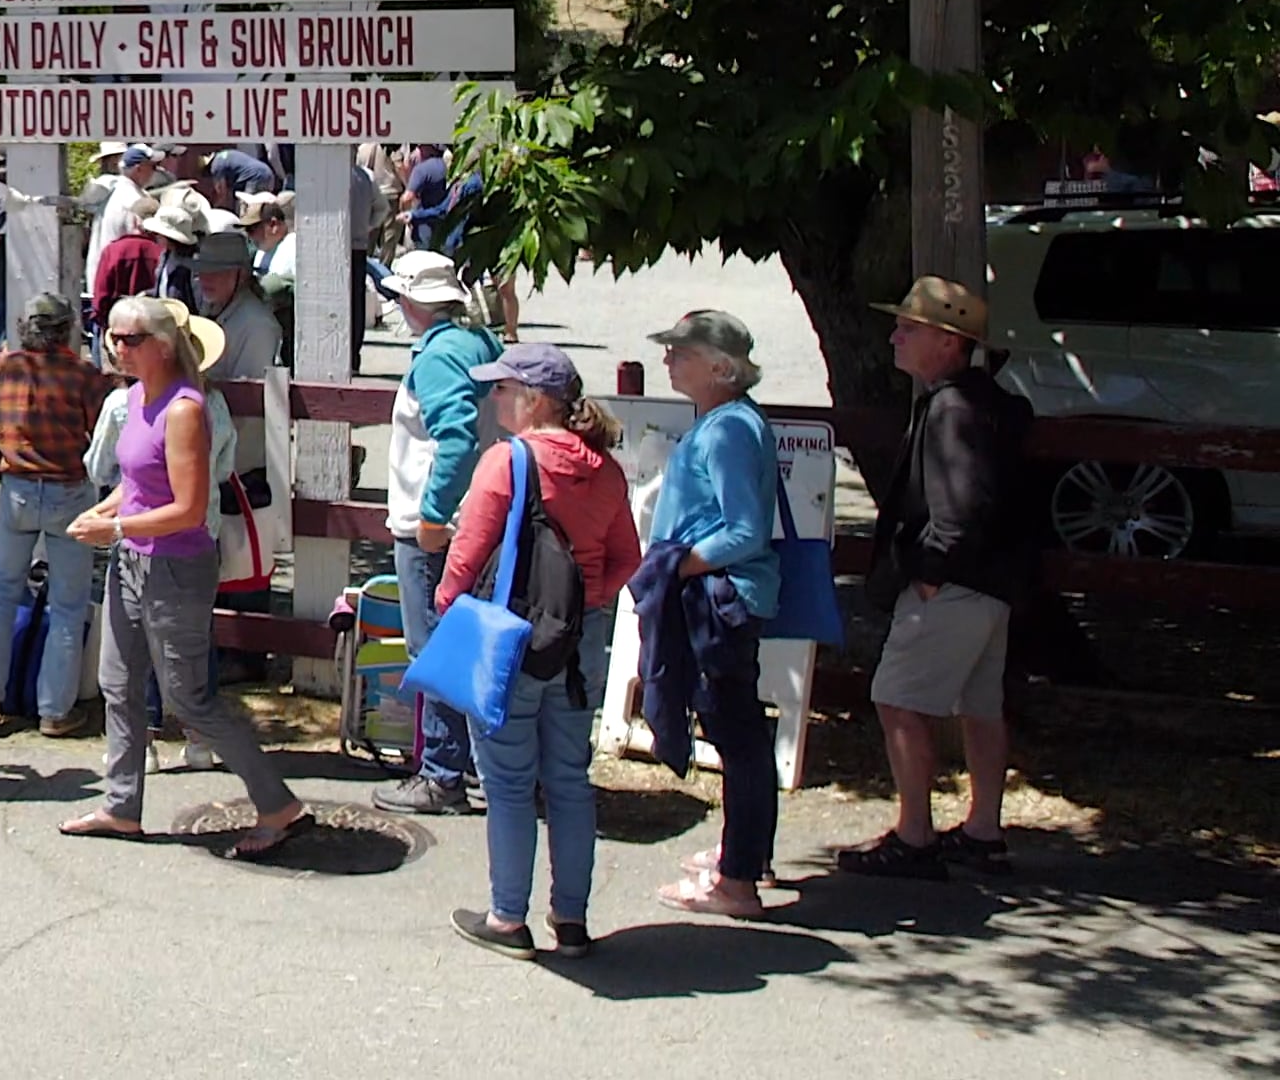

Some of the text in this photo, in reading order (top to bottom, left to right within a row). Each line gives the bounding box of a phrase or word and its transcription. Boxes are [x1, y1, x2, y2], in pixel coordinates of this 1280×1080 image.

[31, 21, 106, 69] DAILY
[138, 19, 188, 68] SAT
[201, 19, 218, 68] &
[231, 18, 286, 67] SUN
[298, 16, 414, 67] BRUNCH
[103, 88, 193, 137] DINING
[226, 88, 289, 137] LIVE
[301, 88, 391, 137] MUSIC
[778, 436, 827, 452] ARKING
